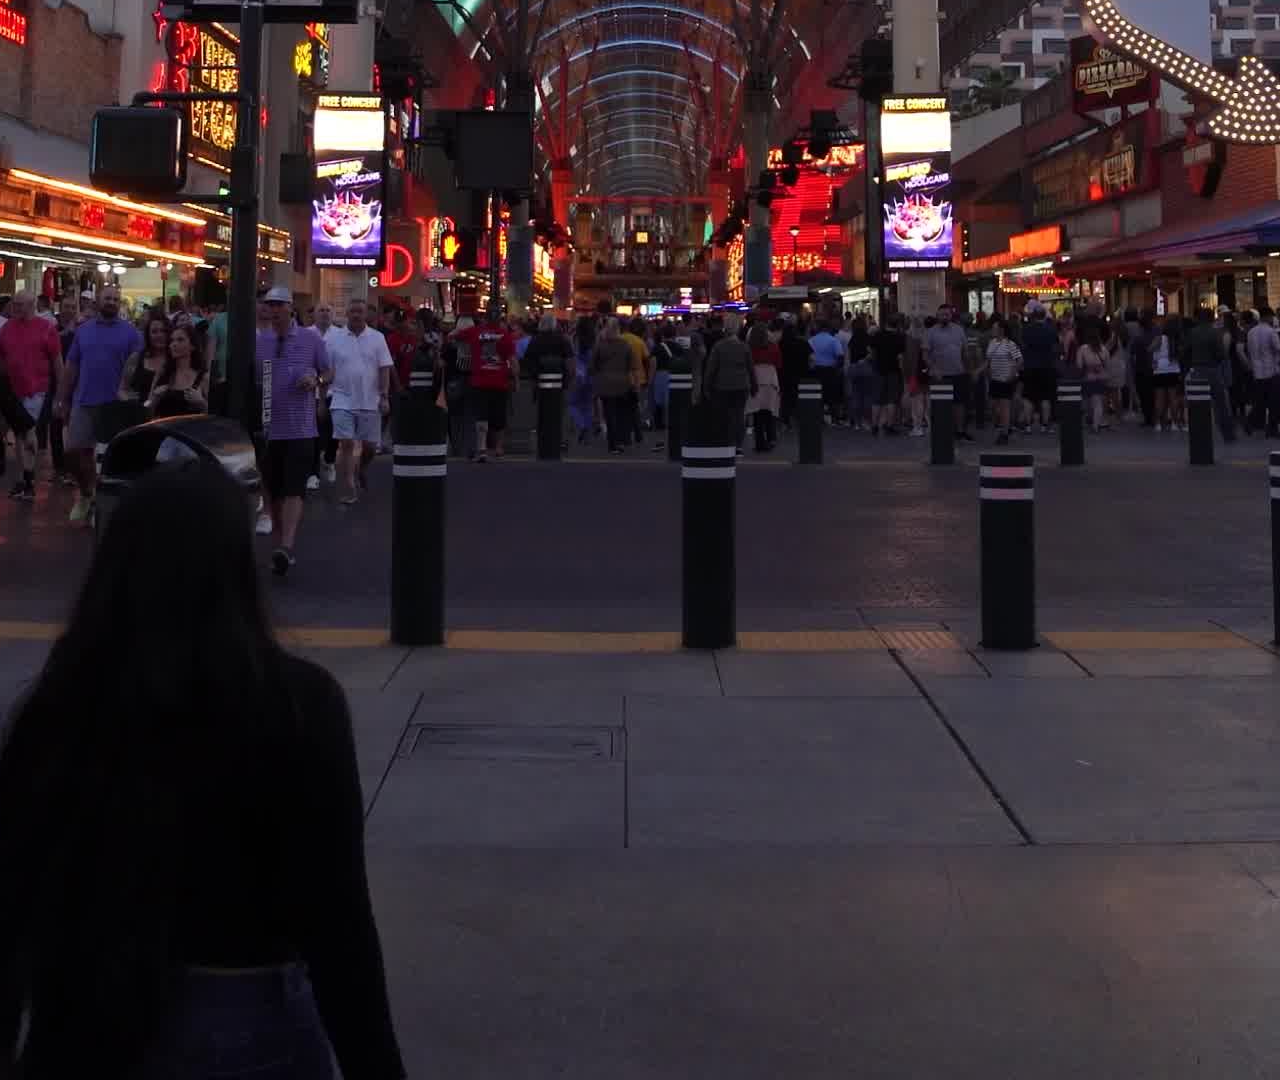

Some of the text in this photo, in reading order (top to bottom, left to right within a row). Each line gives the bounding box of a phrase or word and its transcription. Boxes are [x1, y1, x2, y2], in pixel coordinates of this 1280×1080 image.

[318, 95, 381, 108] FREE CONCERT
[884, 98, 947, 110] FREE CONCERT
